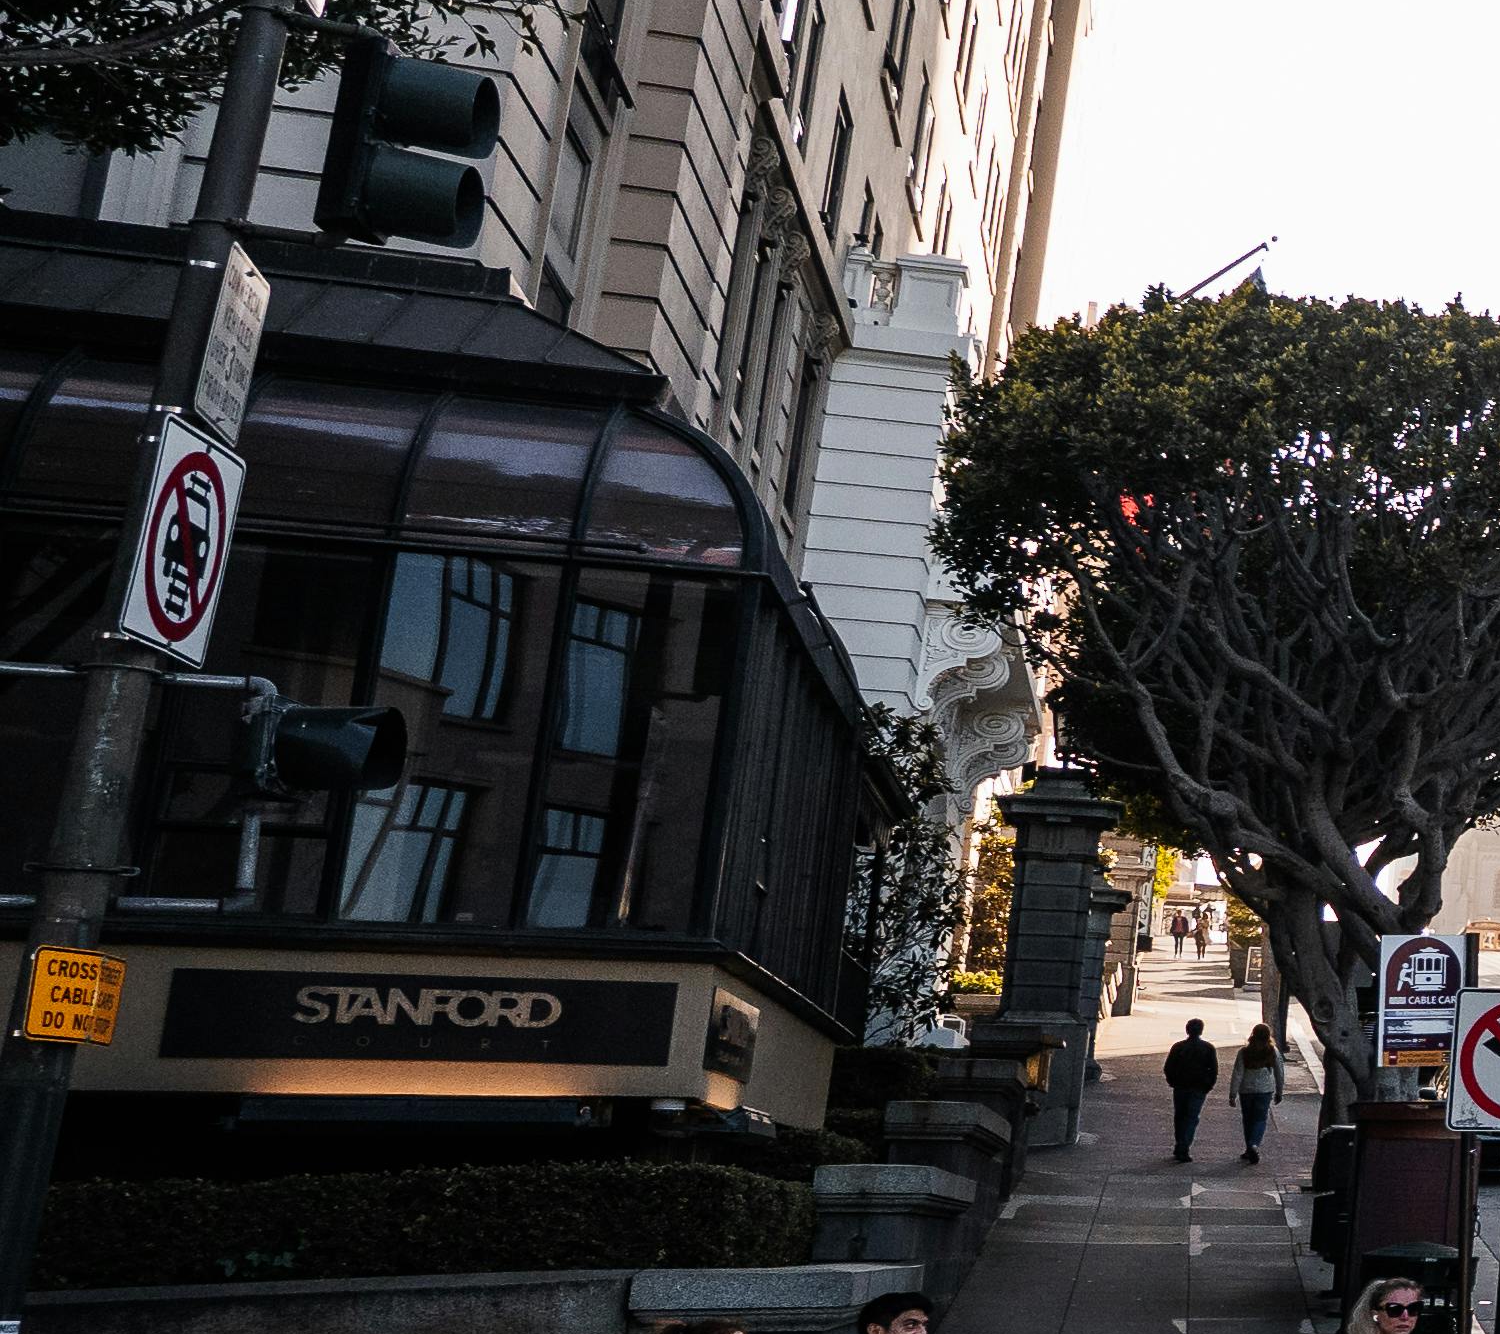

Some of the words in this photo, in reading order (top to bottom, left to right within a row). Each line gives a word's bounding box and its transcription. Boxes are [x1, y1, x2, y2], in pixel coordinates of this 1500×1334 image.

[47, 959, 99, 981] CROSS
[291, 985, 563, 1029] STANFORD
[1408, 995, 1437, 1006] CABLE
[1438, 995, 1457, 1005] CAR
[41, 1011, 65, 1029] DO
[293, 1034, 551, 1051] COURT
